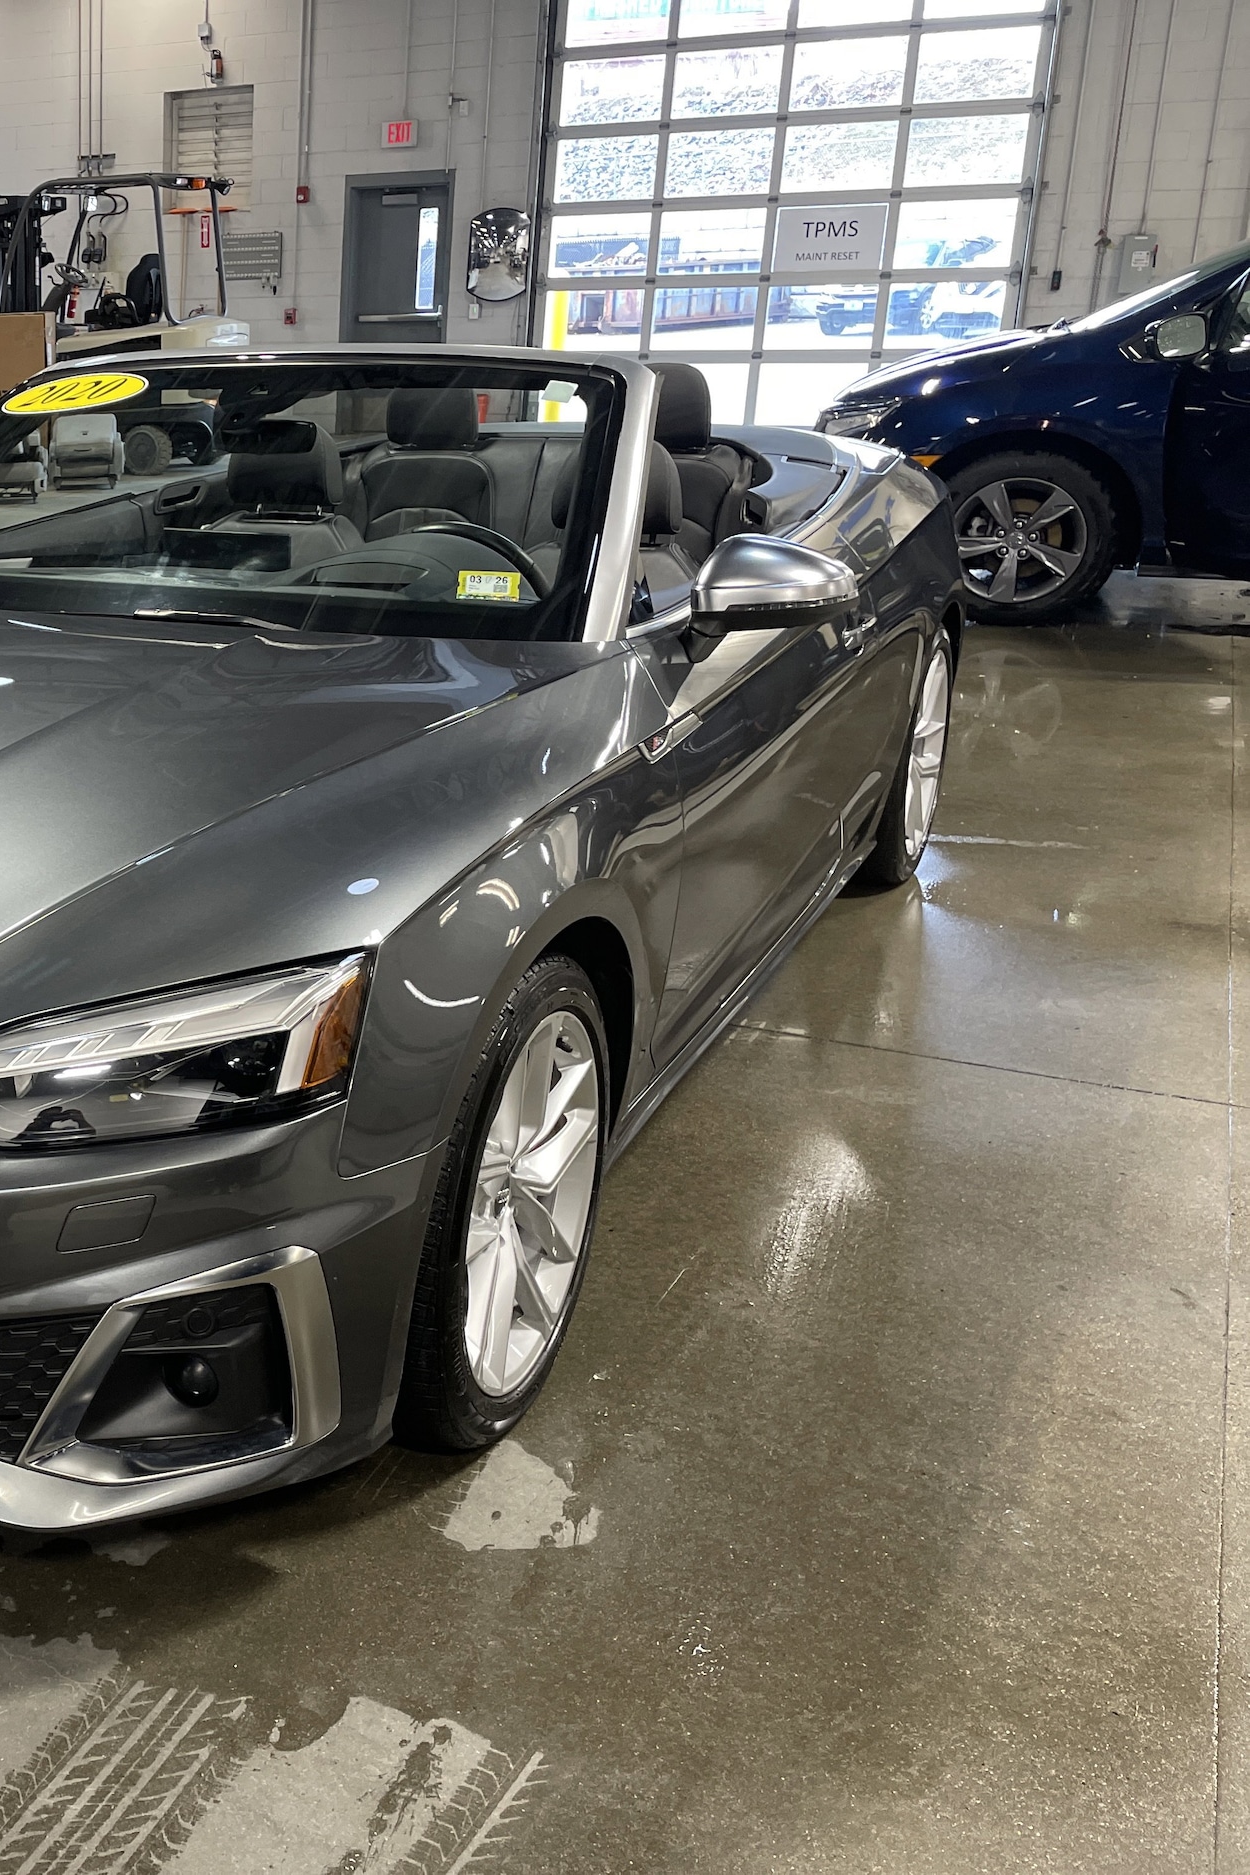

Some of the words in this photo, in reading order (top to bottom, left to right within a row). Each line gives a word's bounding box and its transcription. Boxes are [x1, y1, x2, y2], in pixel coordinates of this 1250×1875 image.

[388, 121, 413, 144] EXIT
[803, 220, 859, 238] TPMS
[795, 252, 829, 262] MAINT
[830, 251, 861, 261] RESET
[16, 378, 128, 408] 2020
[470, 575, 482, 584] 03
[495, 576, 509, 585] 26
